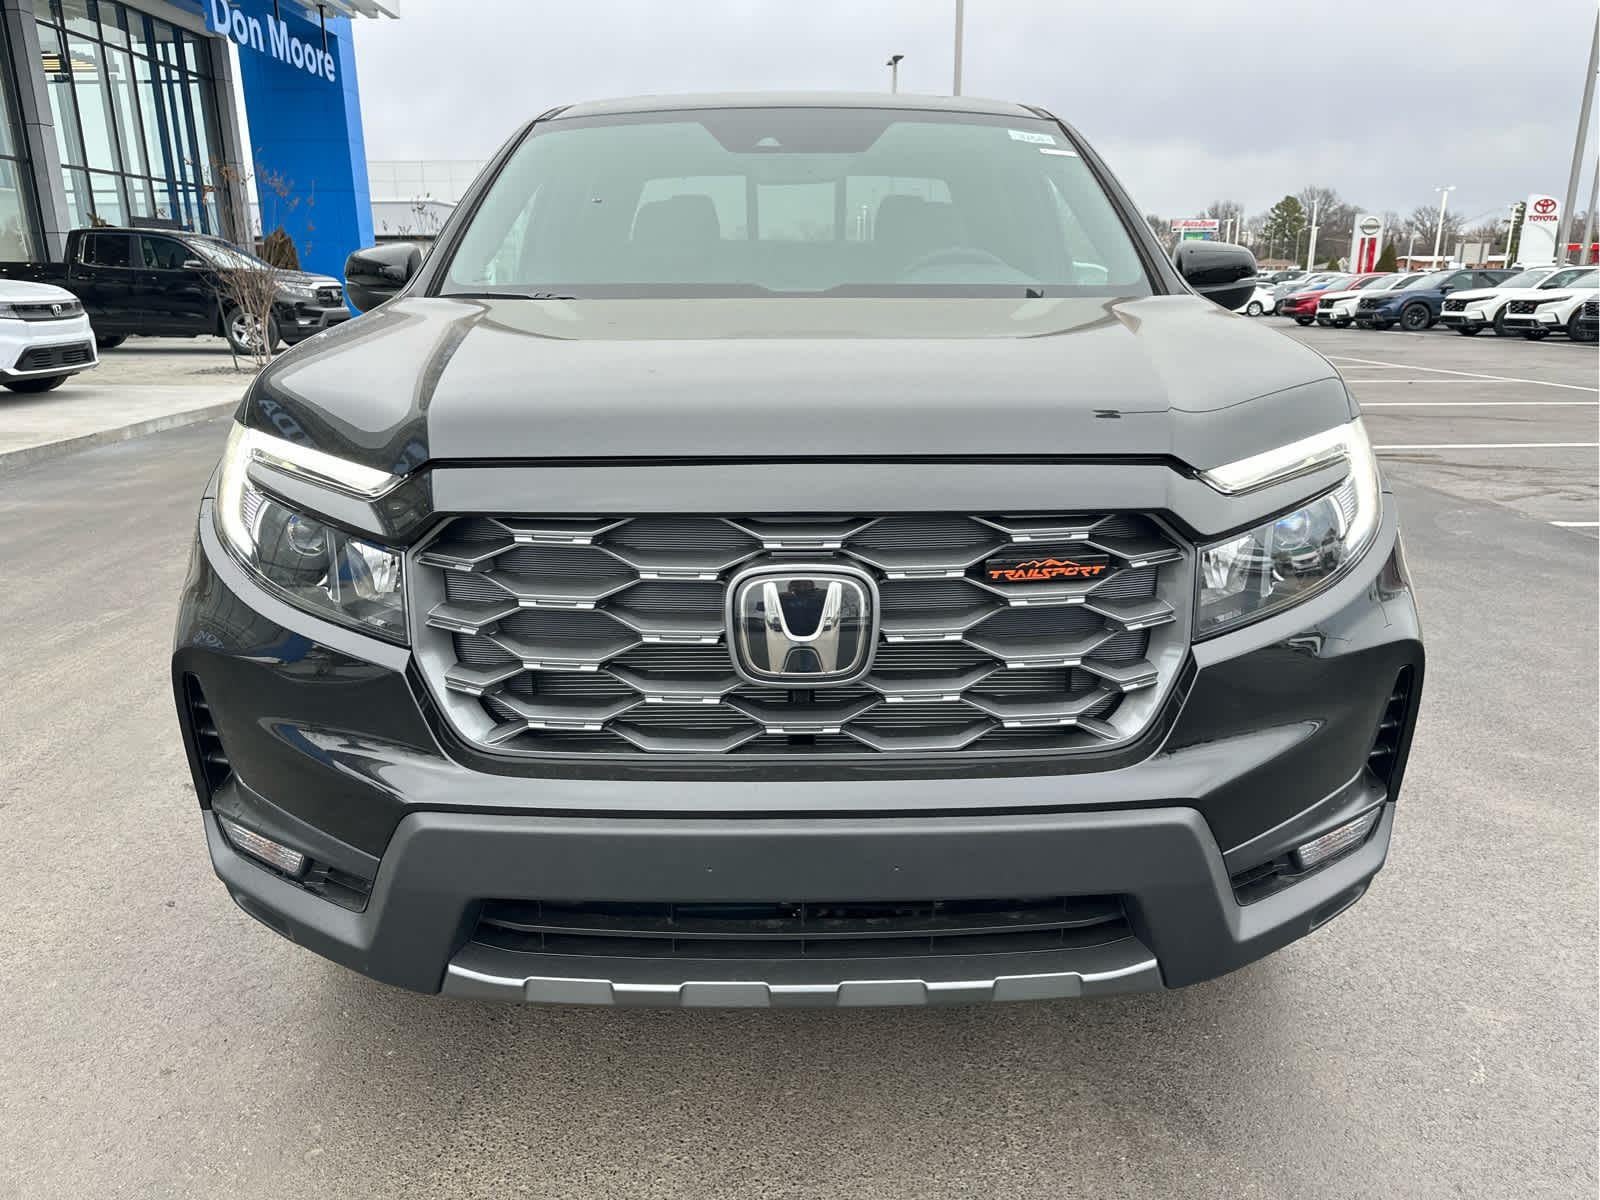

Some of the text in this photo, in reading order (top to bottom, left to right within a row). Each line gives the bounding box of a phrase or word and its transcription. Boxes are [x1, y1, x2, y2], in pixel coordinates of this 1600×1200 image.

[211, 0, 336, 82] Don Moore
[988, 565, 1106, 581] TRAILSPORT
